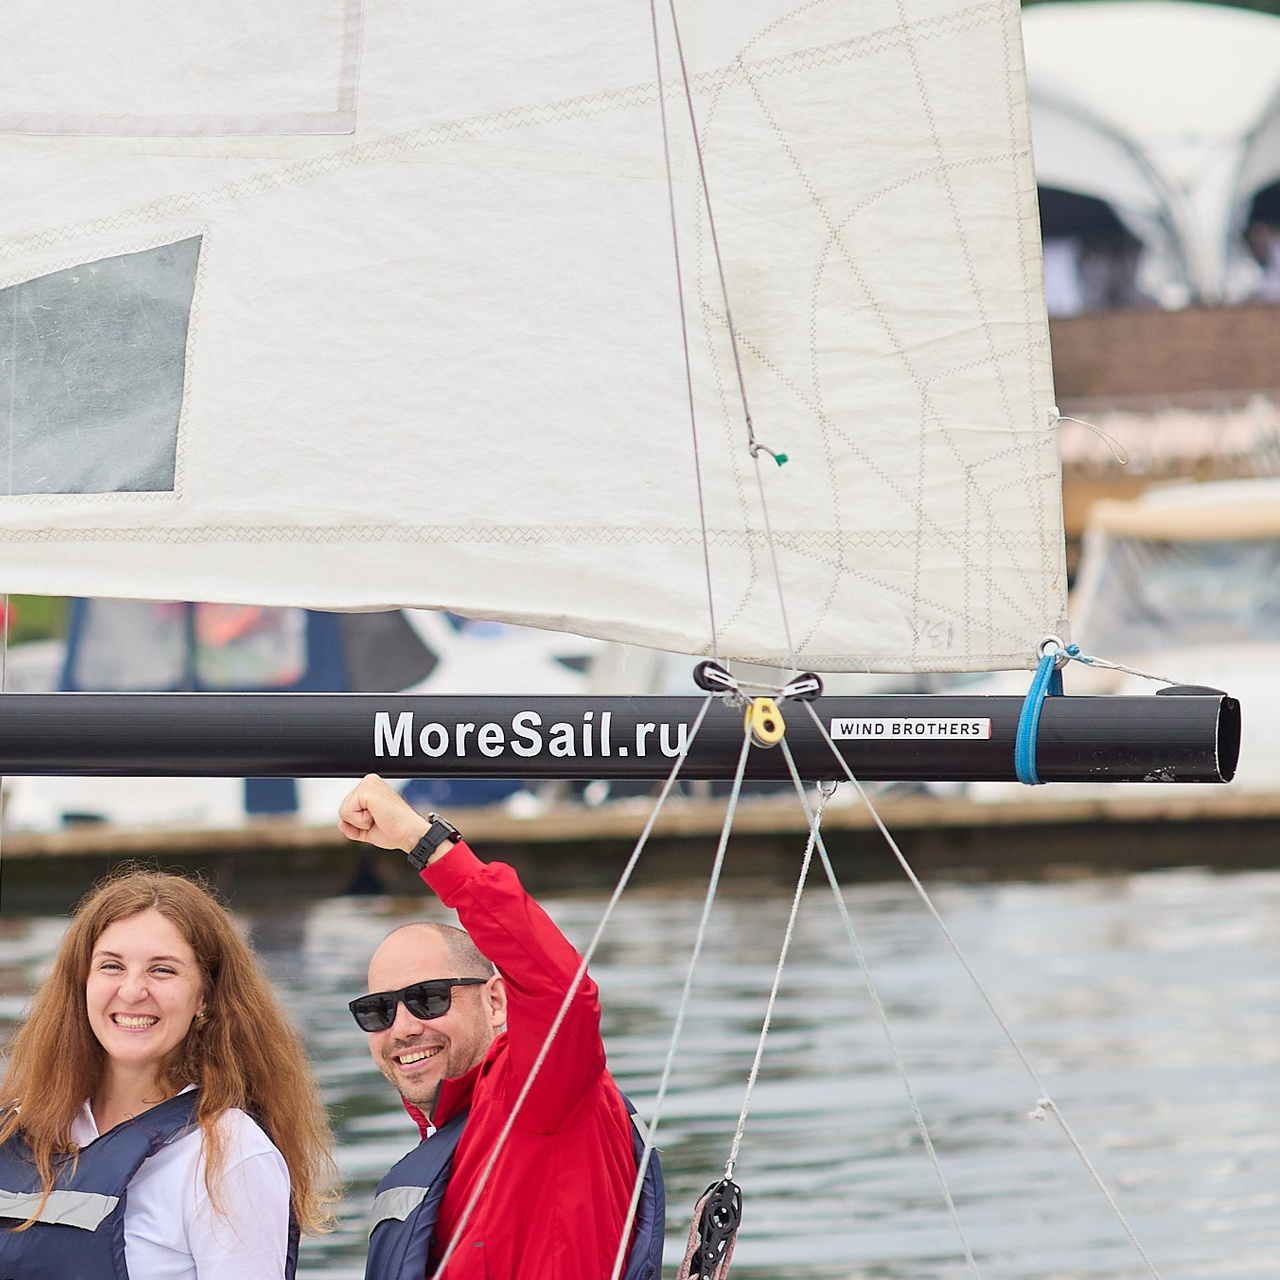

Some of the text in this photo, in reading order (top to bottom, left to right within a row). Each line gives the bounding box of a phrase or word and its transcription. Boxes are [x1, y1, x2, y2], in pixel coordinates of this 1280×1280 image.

[373, 710, 688, 758] MoreSail.ru
[840, 721, 981, 736] WIND BROTHERS
